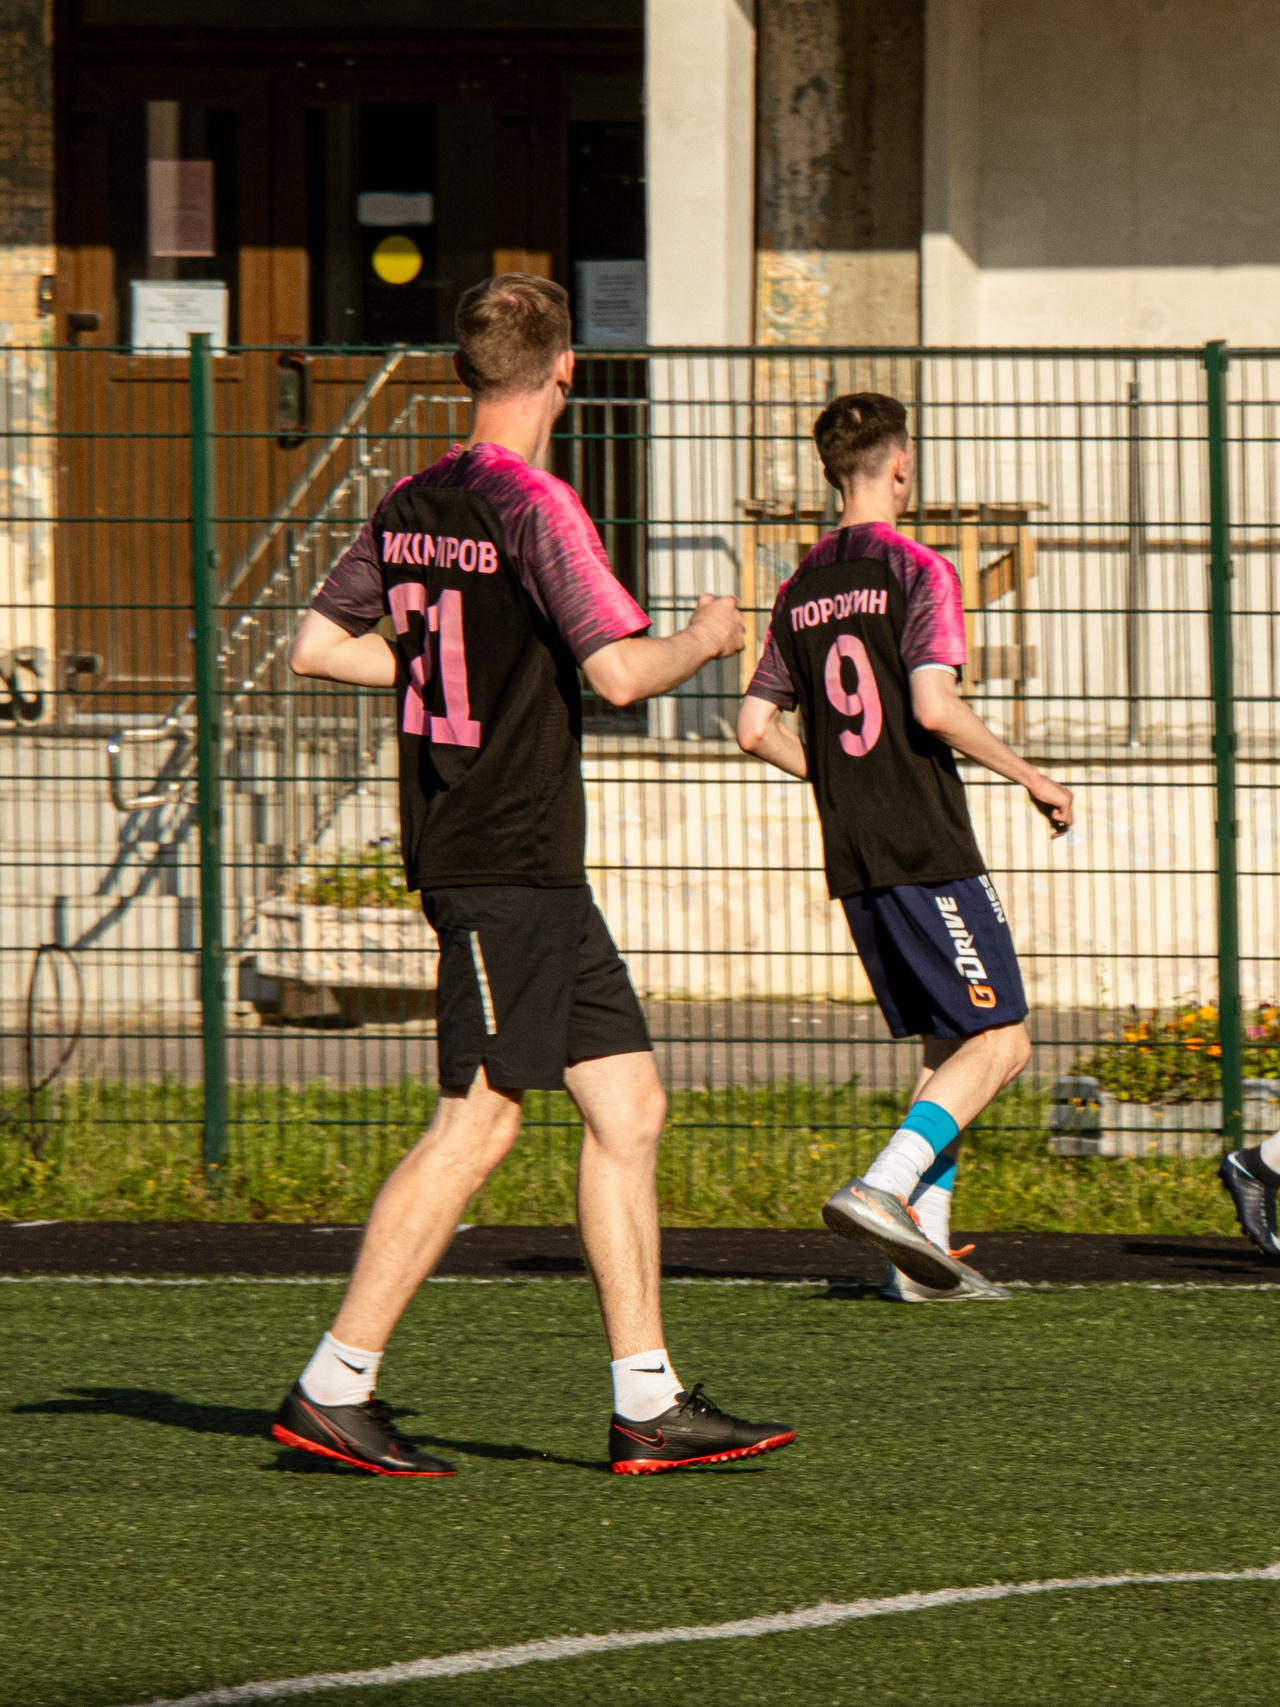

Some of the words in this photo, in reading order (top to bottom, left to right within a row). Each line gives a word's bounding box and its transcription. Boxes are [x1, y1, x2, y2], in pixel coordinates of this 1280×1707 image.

[790, 589, 888, 632] ПОРОХИН
[388, 582, 480, 748] 21
[825, 634, 883, 757] 9
[978, 874, 1006, 924] NISS
